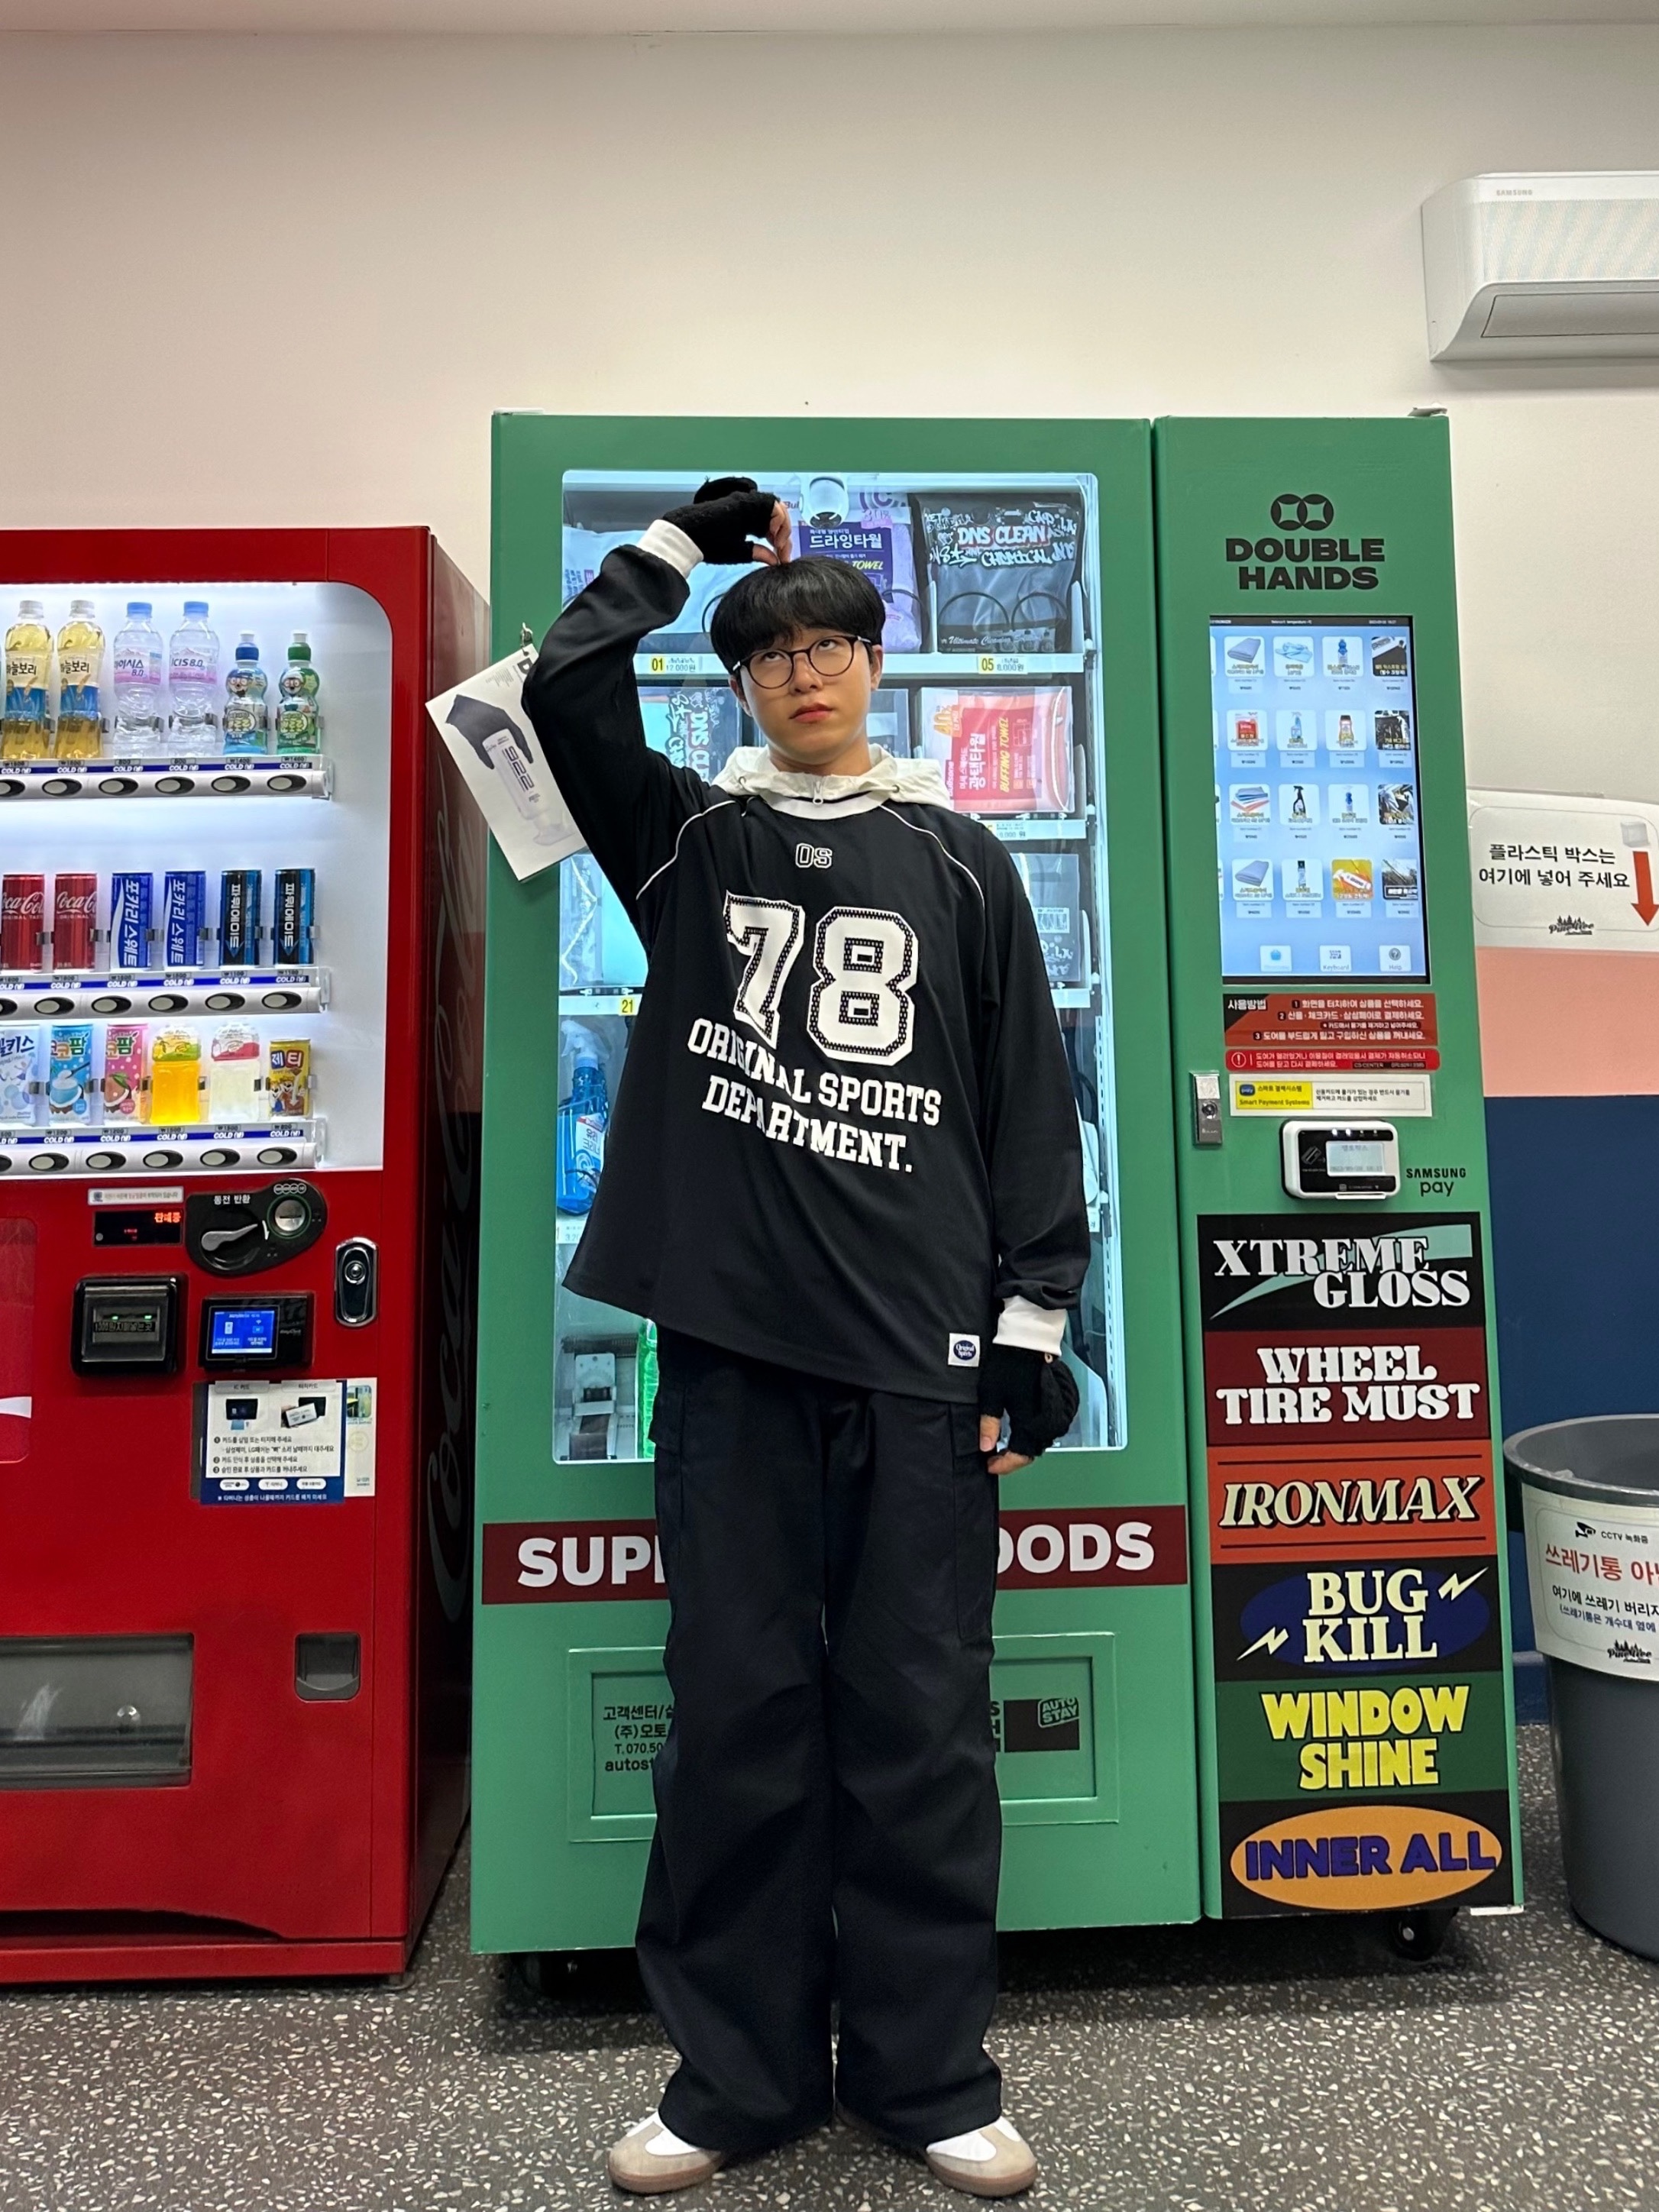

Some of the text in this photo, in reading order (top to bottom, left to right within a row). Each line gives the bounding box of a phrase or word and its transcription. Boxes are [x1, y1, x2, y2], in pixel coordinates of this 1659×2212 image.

[810, 533, 882, 549] 드라잉타월
[958, 526, 991, 545] DNS
[994, 526, 1049, 545] CLEAN
[1226, 538, 1385, 562] DOUBLE
[852, 561, 883, 570] TOWEL
[1239, 567, 1379, 590] HANDS
[189, 658, 203, 668] 8.0
[652, 658, 663, 671] 01
[981, 658, 994, 671] 05
[690, 712, 708, 746] DNS
[969, 732, 986, 791] 광택타월
[998, 717, 1011, 793] BUFFING TOWEL
[795, 843, 833, 868] OS
[1489, 844, 1615, 864] 플라스틱 박스는
[1479, 868, 1630, 888] 여기에 넣어 주세요
[124, 879, 140, 967] 포카리 스웨트
[171, 879, 186, 964] 포카리 스웨트
[230, 883, 241, 948] 파워에이드
[283, 883, 295, 948] 파워에이드
[723, 890, 919, 1066] 78
[622, 999, 633, 1014] 21
[1227, 999, 1266, 1011] 사용방법
[1302, 999, 1325, 1008] 화면을
[1327, 999, 1358, 1008] 터치하여
[1263, 1032, 1286, 1040] 도어를
[1337, 1031, 1367, 1040] 구입하신
[271, 1050, 303, 1069] 제티
[687, 1017, 942, 1127] ORIGINAL SPORTS
[702, 1075, 913, 1173] DEPARTMENT.
[1406, 1168, 1467, 1179] SAMSUNG
[214, 1194, 251, 1205] 동전 반환
[1420, 1182, 1454, 1197] pay
[1213, 1237, 1429, 1276] XTREME
[1313, 1269, 1470, 1309] GLOSS
[1256, 1345, 1437, 1383] WHEEL
[1216, 1383, 1480, 1425] TIRE MUST
[1218, 1476, 1480, 1527] IRONMAX
[1601, 1531, 1648, 1544] CCTV 녹화중
[518, 1535, 665, 1588] SUP
[1546, 1544, 1622, 1581] 쓰레기통
[1307, 1568, 1428, 1616] BUG
[1552, 1584, 1582, 1605] 여기에
[1585, 1593, 1620, 1613] 쓰레기
[1605, 1615, 1633, 1630] 개수대
[1302, 1615, 1437, 1663] KILL
[1042, 1696, 1075, 1713] AUTO
[1042, 1704, 1077, 1723] STAY
[1260, 1685, 1470, 1739] WINDOW
[1299, 1738, 1439, 1790] SHINE
[1246, 1831, 1496, 1881] INNER ALL
